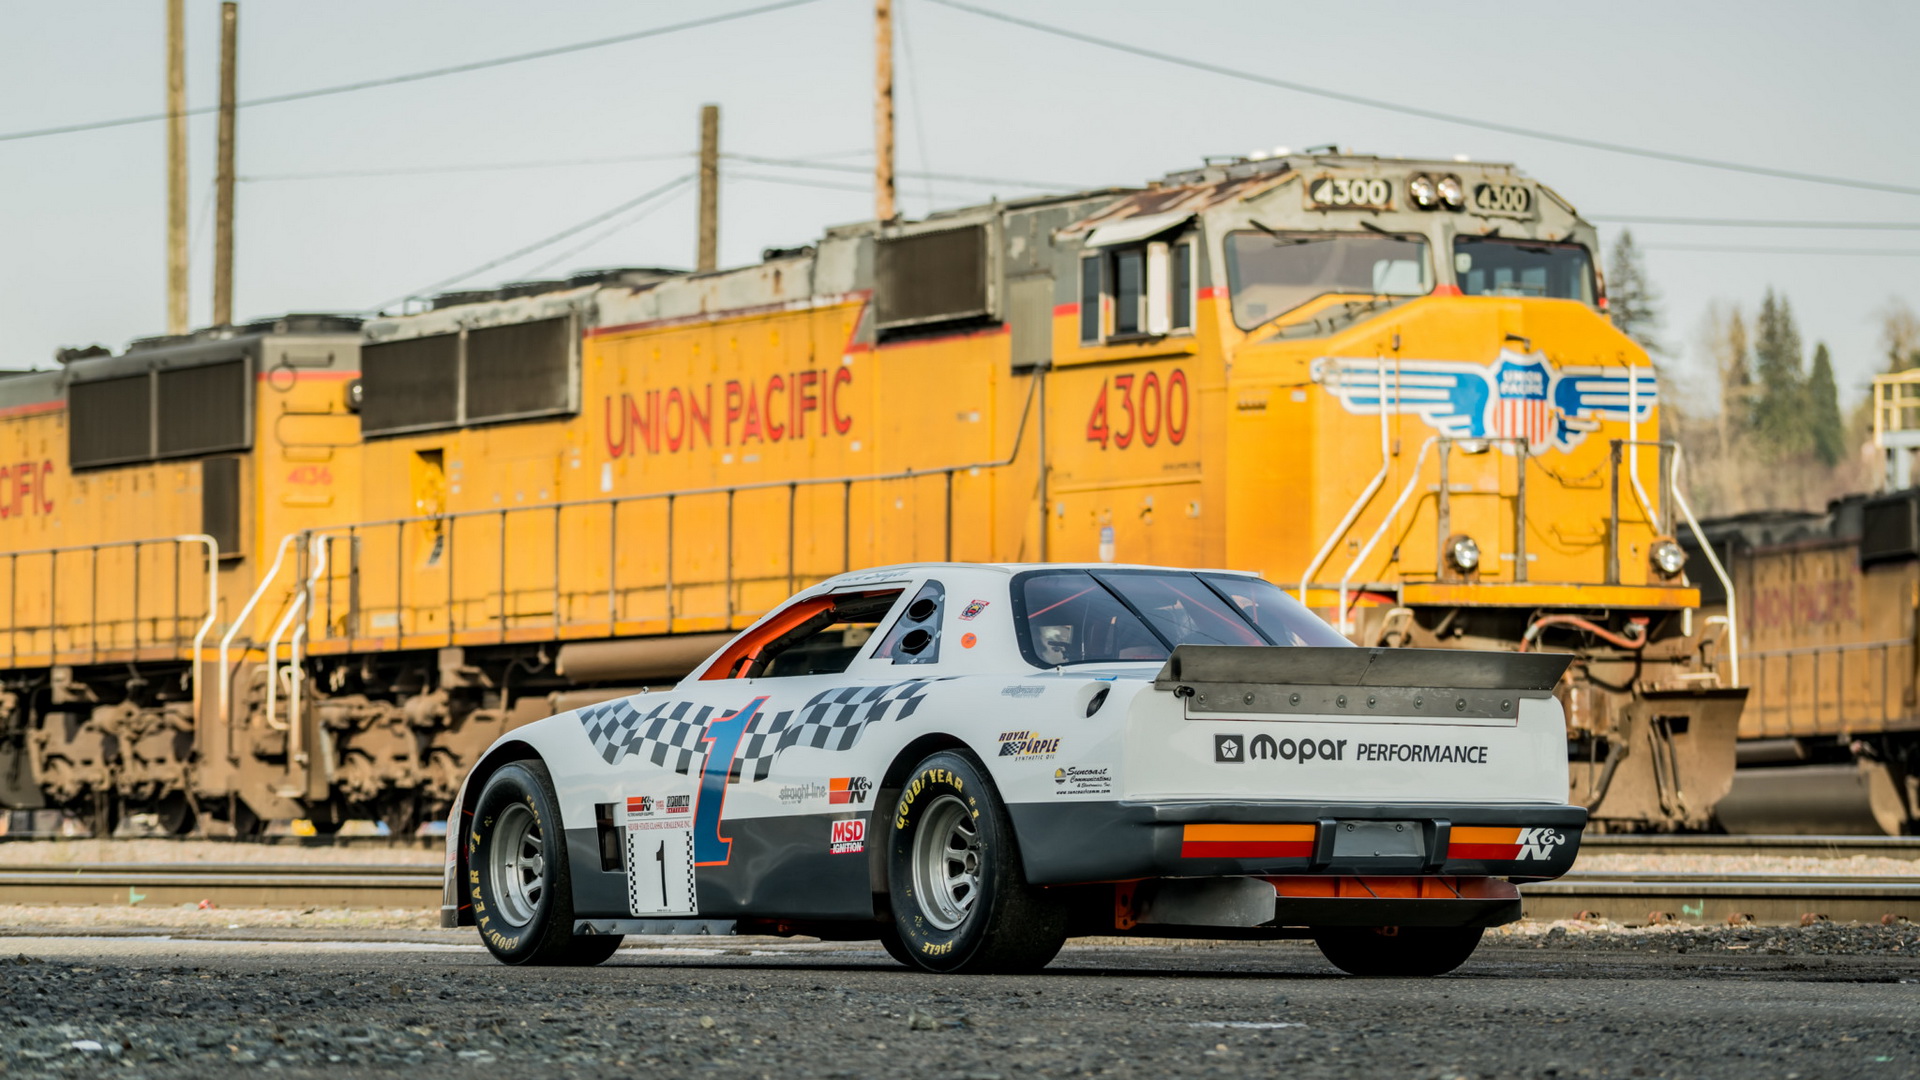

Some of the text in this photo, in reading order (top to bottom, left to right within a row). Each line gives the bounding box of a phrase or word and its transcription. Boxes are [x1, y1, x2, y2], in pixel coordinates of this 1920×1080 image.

[1314, 178, 1388, 205] 4300
[1478, 186, 1528, 211] 4300
[606, 366, 852, 458] UNION PACIFIC
[1086, 368, 1189, 450] 4300
[999, 730, 1030, 741] ROYAL
[1017, 738, 1060, 755] PURPLE
[1356, 743, 1488, 763] PERFORMANCE
[694, 696, 771, 867] 1
[1067, 766, 1107, 775] Suncoast
[895, 768, 963, 830] GOODYEAR
[833, 821, 864, 842] MSD
[833, 842, 862, 854] IGNITION
[655, 839, 668, 907] 1
[470, 870, 520, 951] GOODYEAR
[921, 940, 953, 955] EAGLE
